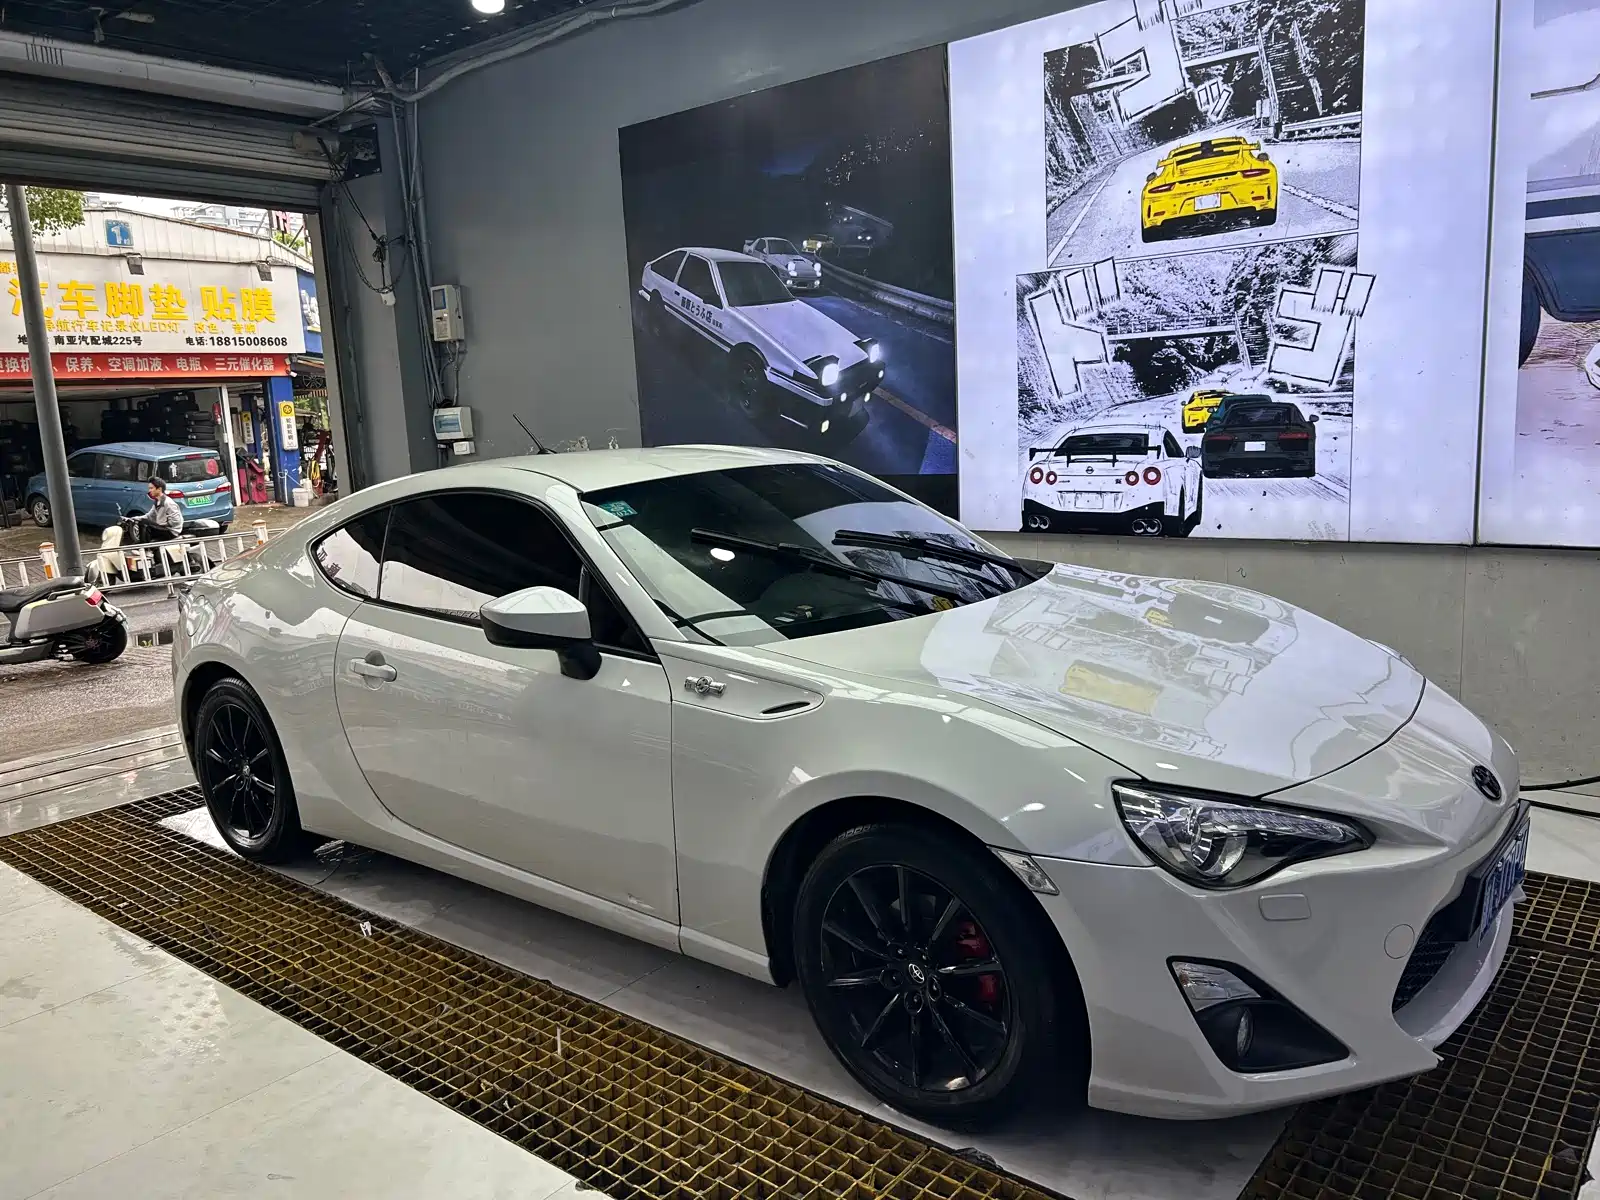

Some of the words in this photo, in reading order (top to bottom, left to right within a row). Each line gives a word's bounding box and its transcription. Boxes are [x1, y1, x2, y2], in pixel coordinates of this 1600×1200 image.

[200, 286, 276, 323] 贴膜
[18, 335, 143, 346] 地:南亚汽配城225号
[0, 356, 275, 372] 换机、保养、空调加液、电瓶、三元催化器
